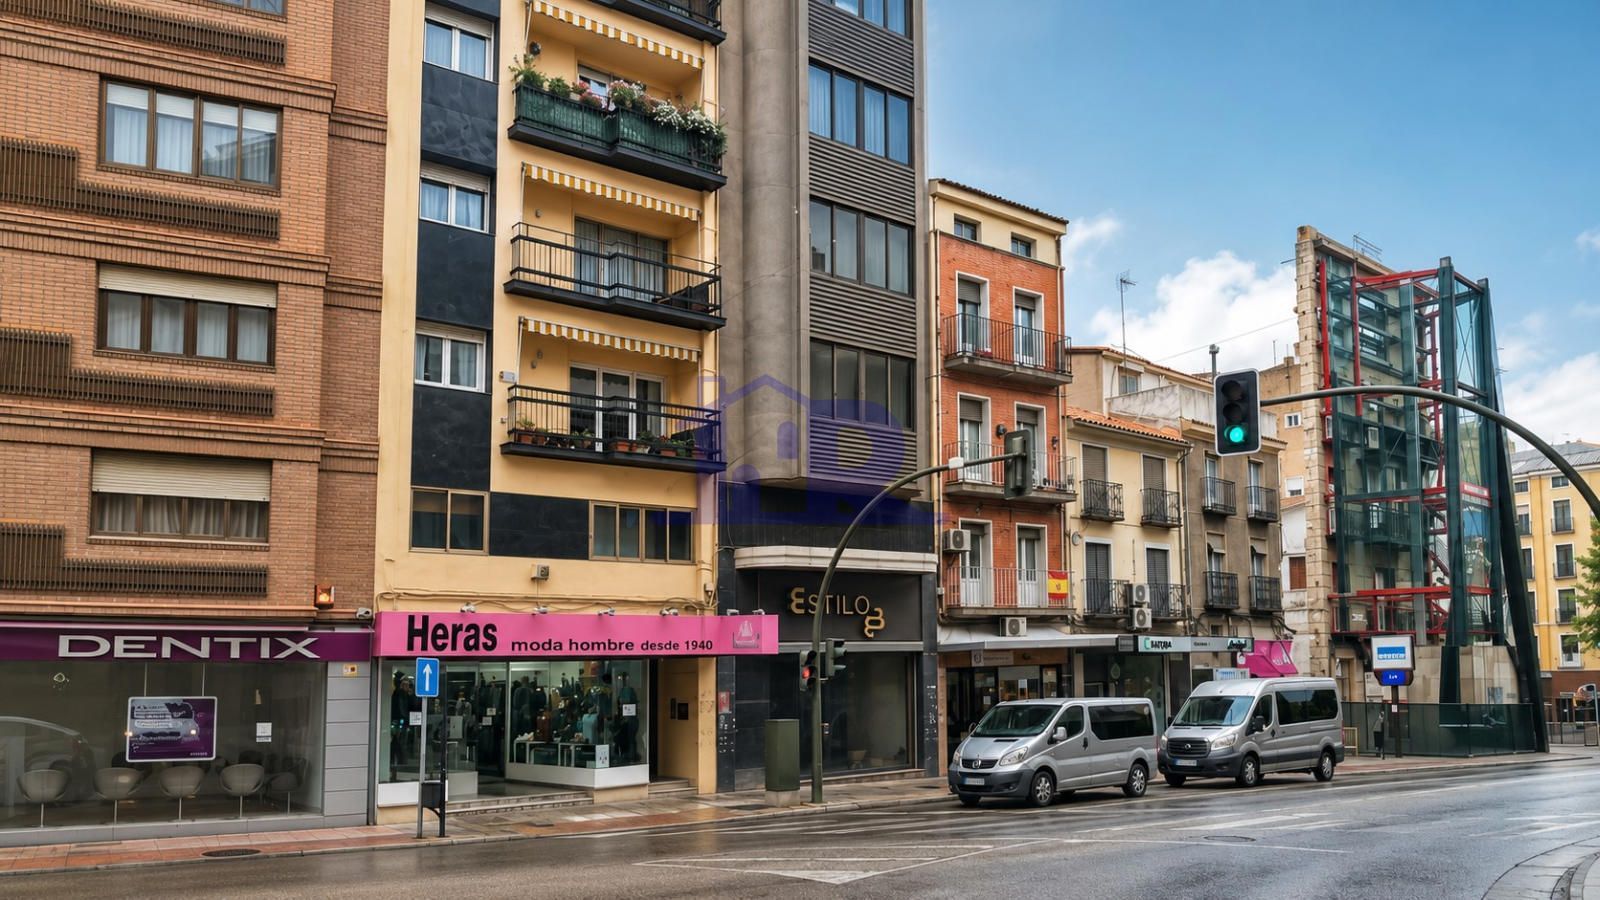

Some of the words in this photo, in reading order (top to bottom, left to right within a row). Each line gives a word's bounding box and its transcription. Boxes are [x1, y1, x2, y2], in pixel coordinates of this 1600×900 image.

[790, 587, 870, 615] ESTILO
[58, 634, 321, 660] DENTIX
[406, 614, 499, 653] Heras
[511, 638, 564, 652] moda
[569, 637, 635, 652] hombre
[640, 638, 680, 652] desde
[683, 639, 714, 651] 1940
